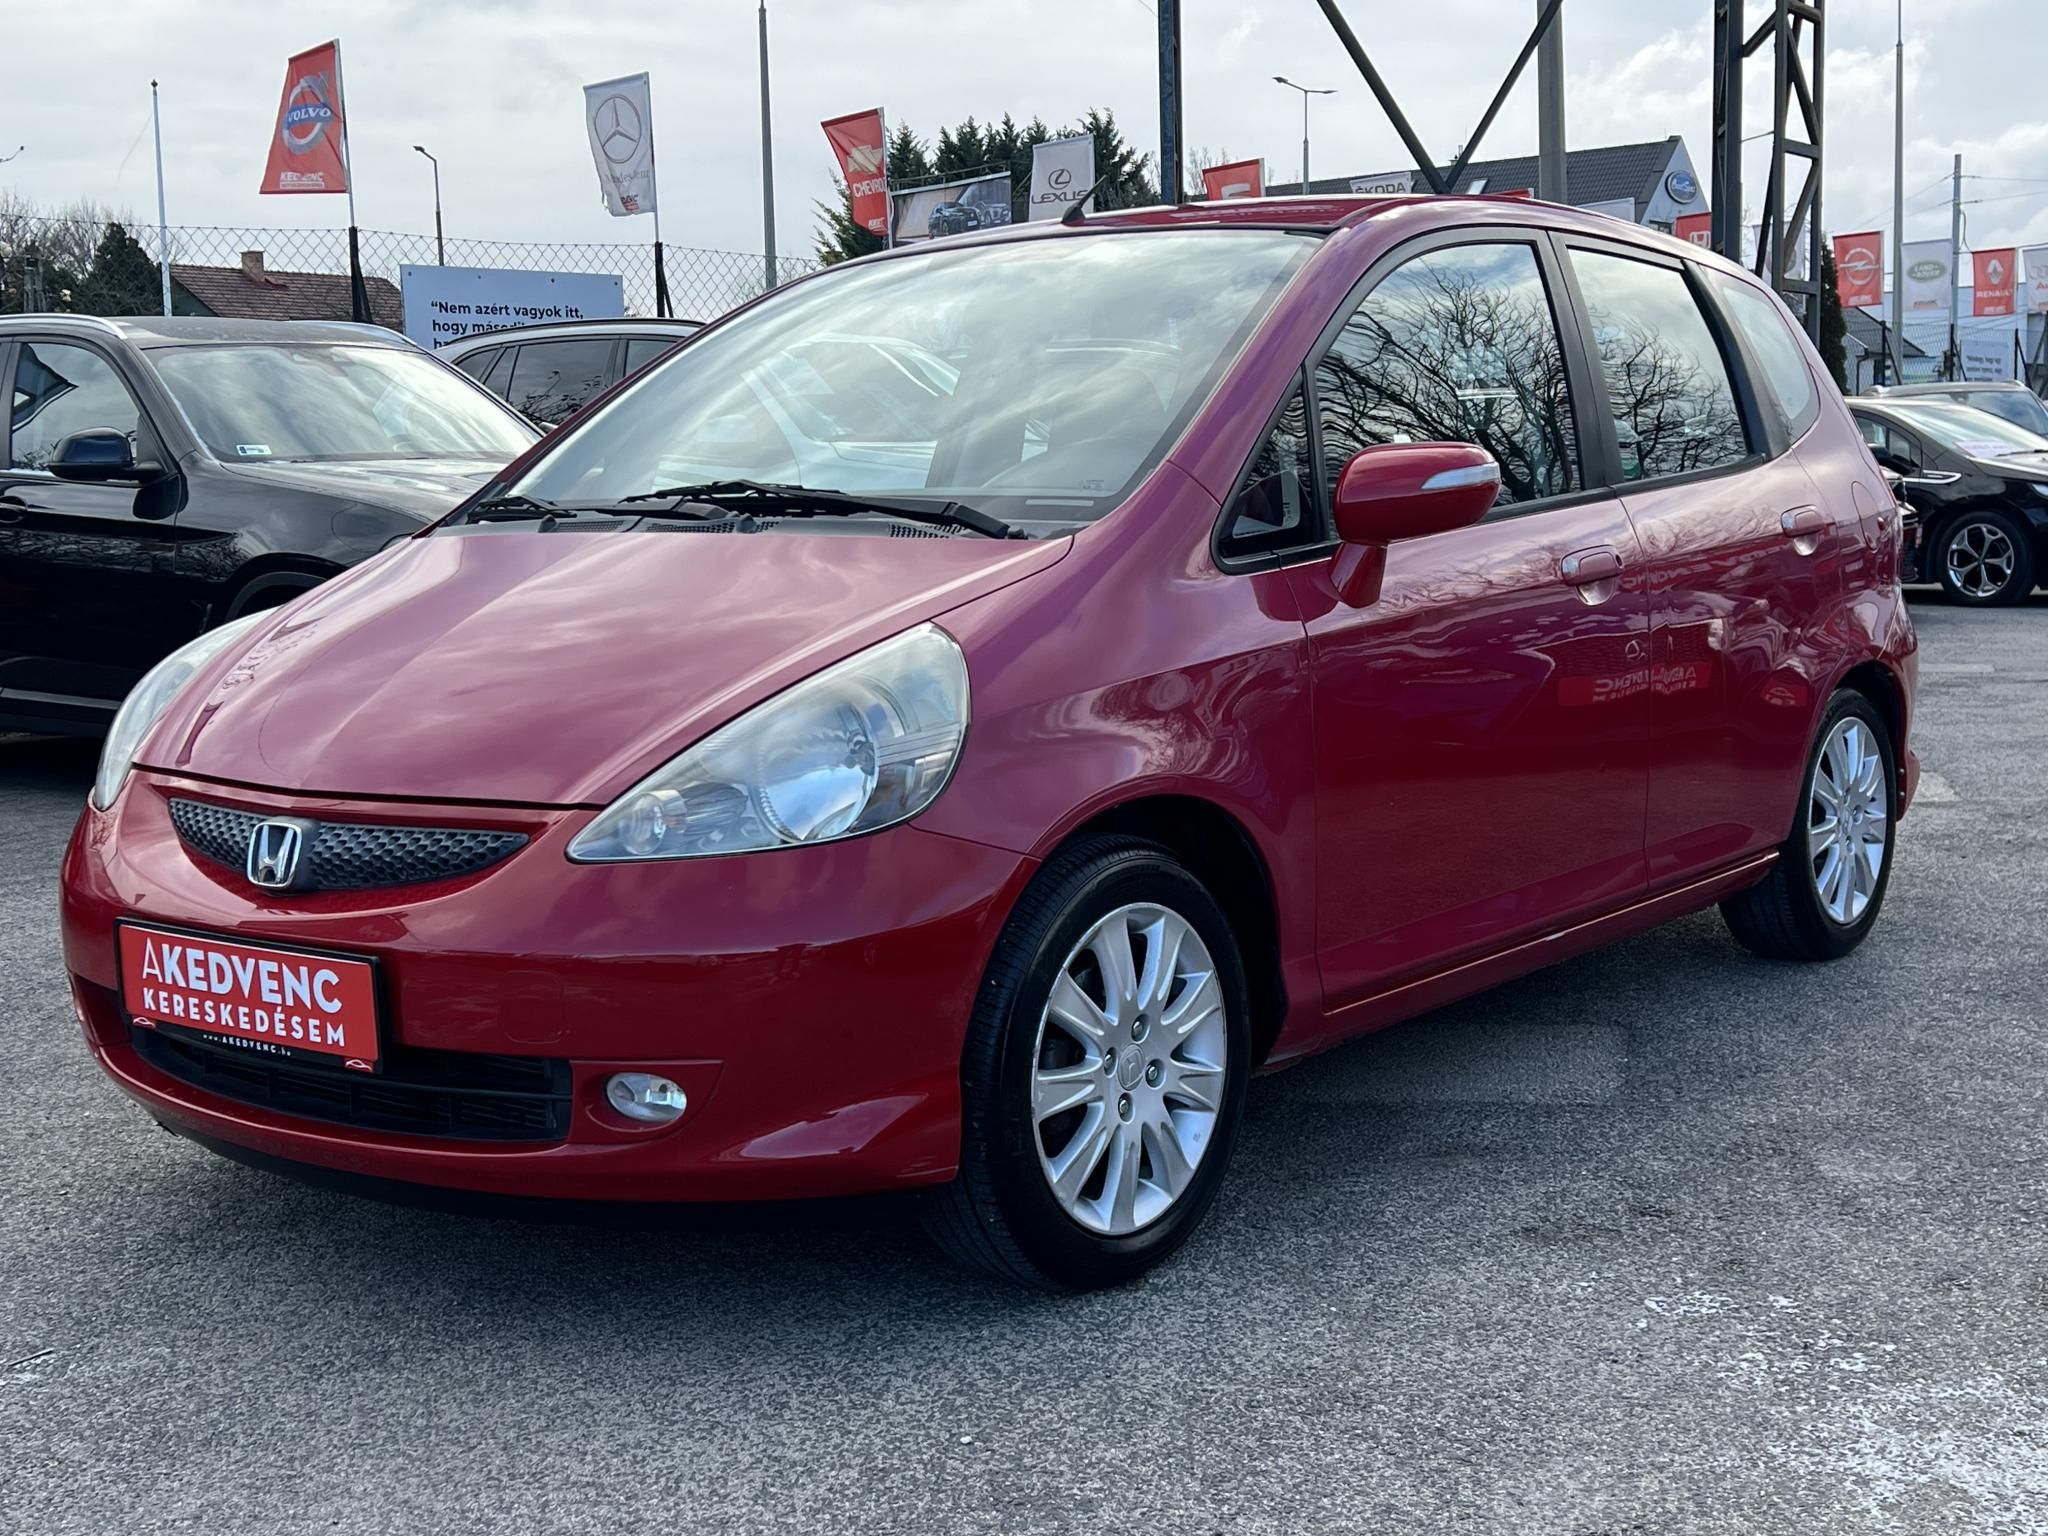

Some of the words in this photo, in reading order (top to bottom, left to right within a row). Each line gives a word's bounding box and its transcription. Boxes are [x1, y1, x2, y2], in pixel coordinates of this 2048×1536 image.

[288, 106, 332, 123] VOLVO
[1031, 189, 1090, 204] LEXUS
[1975, 288, 2013, 298] RENAULT
[475, 303, 510, 316] azért
[514, 305, 562, 320] vagyok
[565, 306, 584, 319] itt,
[432, 320, 468, 335] hogy
[142, 986, 346, 1048] KERESKEDÉSEM
